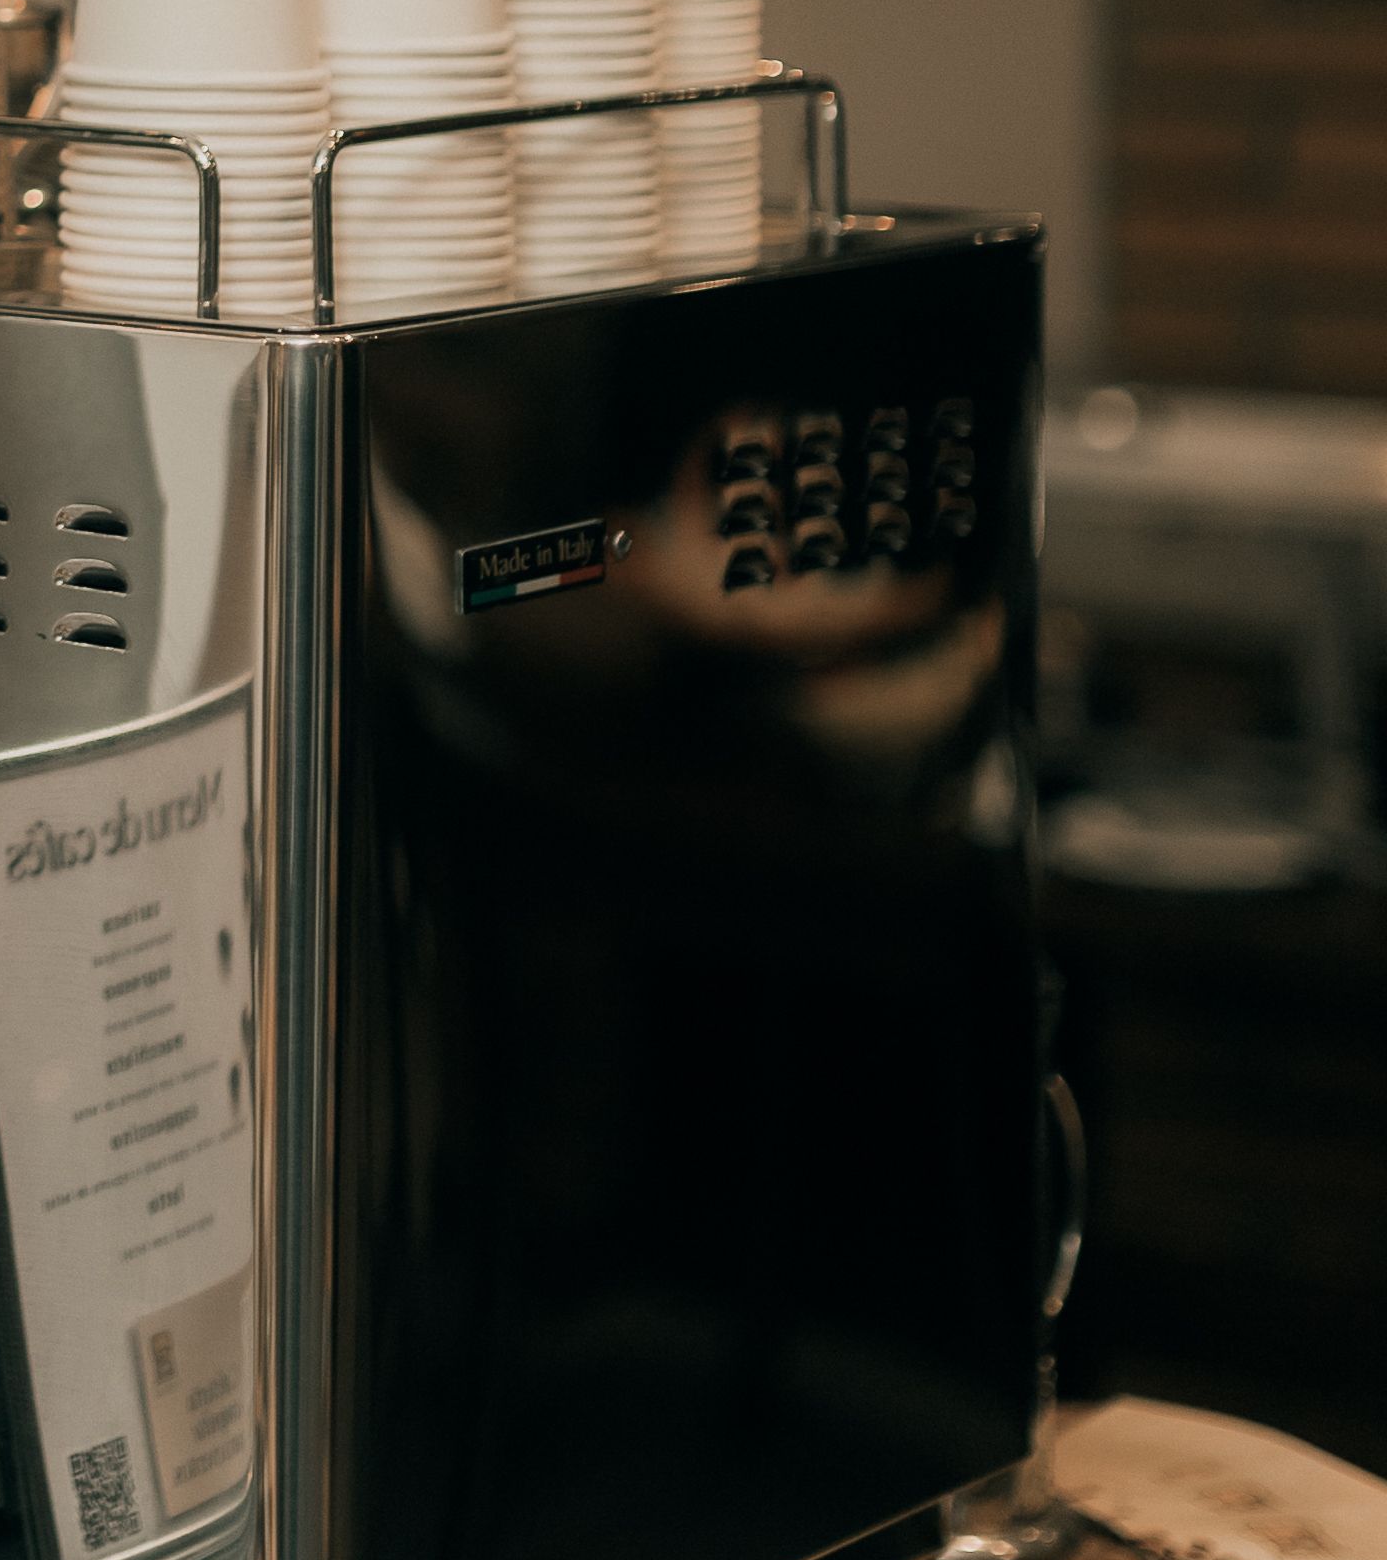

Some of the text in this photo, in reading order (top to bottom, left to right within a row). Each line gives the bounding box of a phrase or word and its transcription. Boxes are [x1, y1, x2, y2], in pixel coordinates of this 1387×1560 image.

[479, 532, 595, 579] Made in Italy
